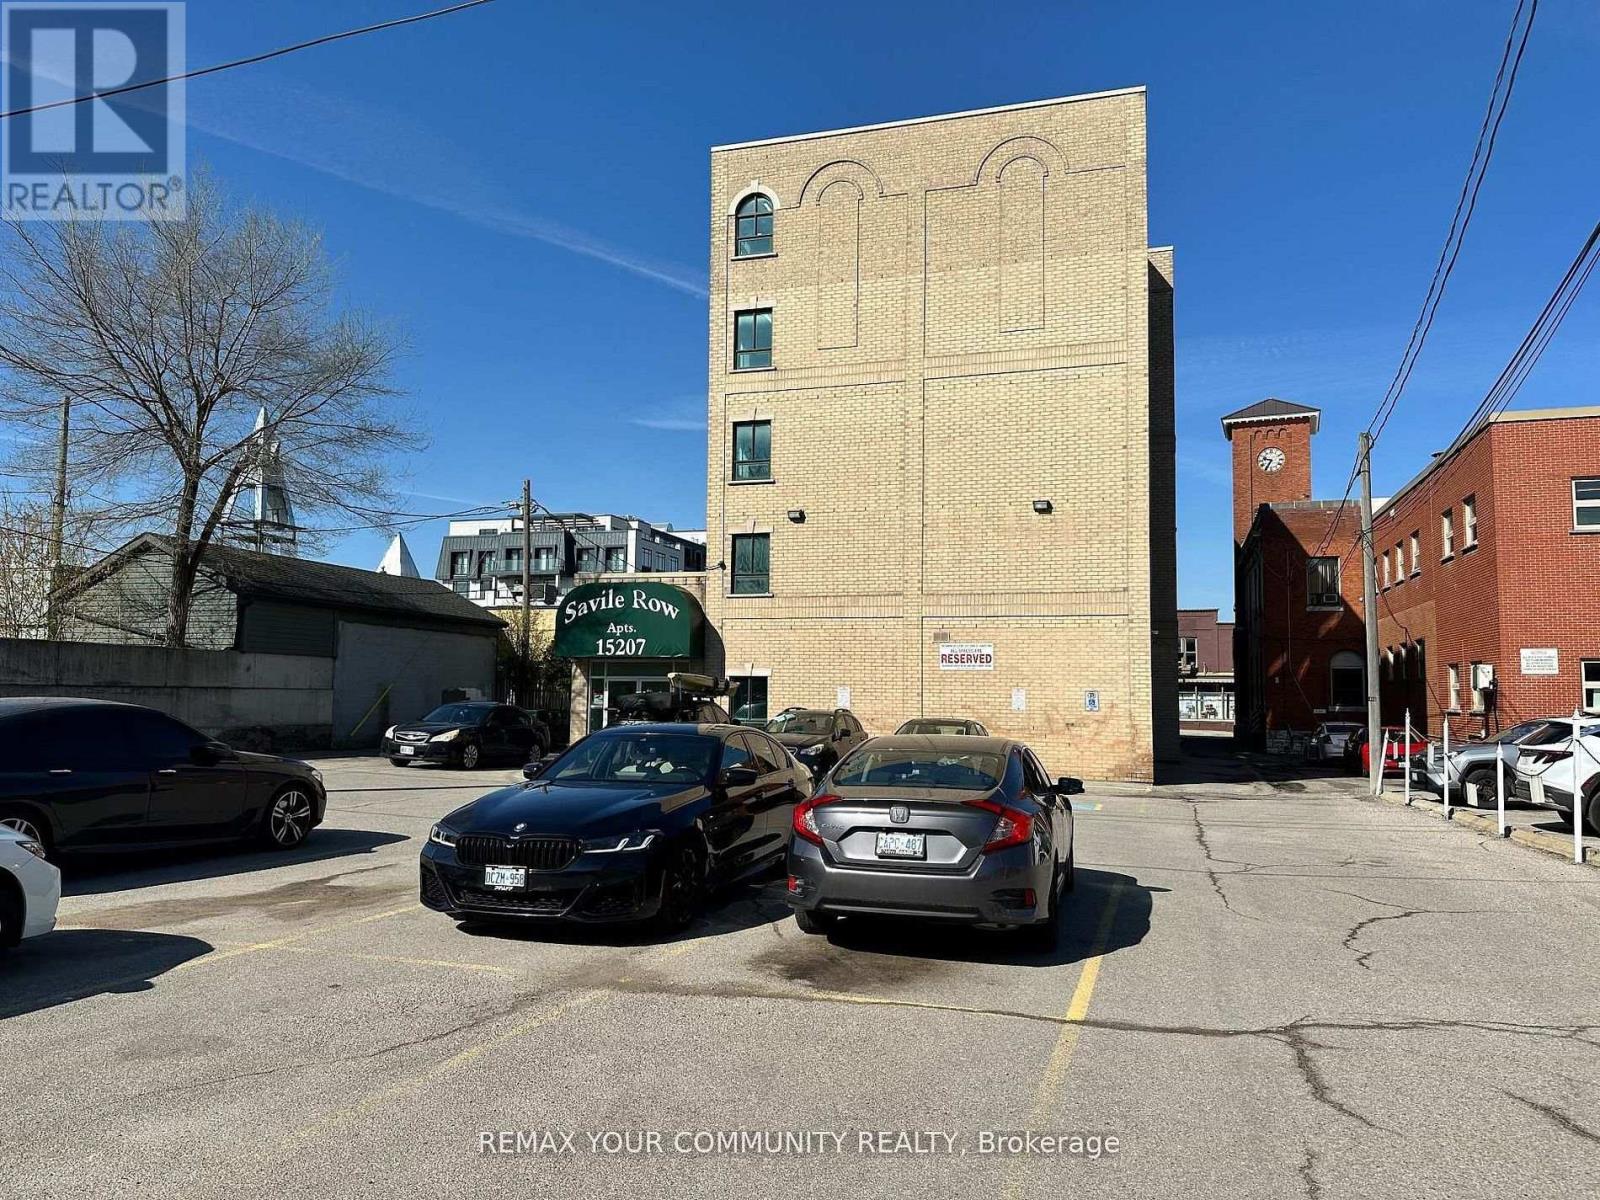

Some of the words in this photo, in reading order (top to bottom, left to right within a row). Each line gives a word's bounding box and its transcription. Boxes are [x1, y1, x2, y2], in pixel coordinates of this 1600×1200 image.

[564, 588, 625, 625] Savile
[632, 589, 680, 621] Row
[606, 622, 637, 637] Apts.
[595, 638, 647, 656] 15207
[941, 653, 992, 664] RESERVED
